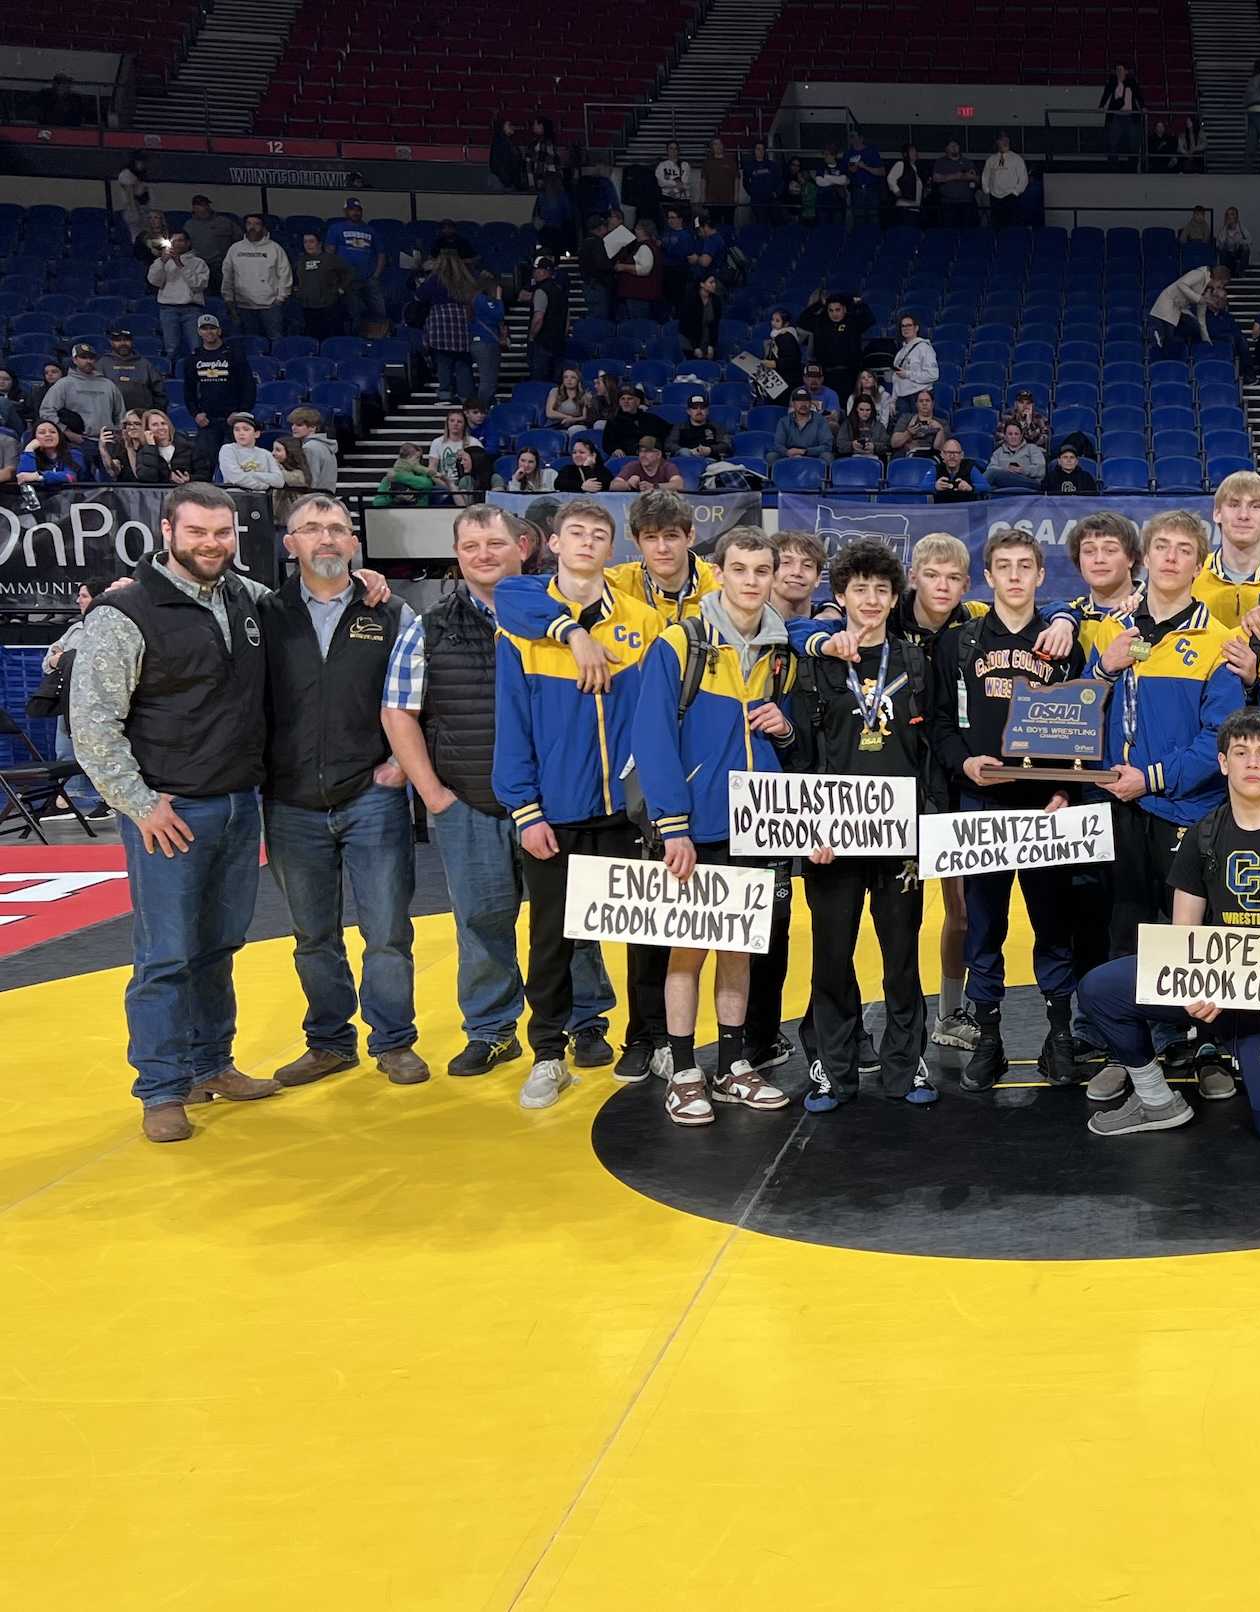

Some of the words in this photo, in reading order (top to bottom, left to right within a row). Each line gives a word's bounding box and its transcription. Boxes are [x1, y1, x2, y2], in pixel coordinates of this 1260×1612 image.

[266, 141, 284, 153] 12
[0, 503, 251, 571] nPot
[614, 625, 641, 648] CC
[1175, 638, 1199, 666] CC
[1012, 649, 1054, 683] COUNTY
[1028, 702, 1081, 722] OSAA
[1051, 727, 1097, 737] WRESTLING
[748, 779, 894, 815] VILLASTRIGO
[734, 805, 753, 836] 10
[755, 818, 824, 848] CROOK
[829, 818, 909, 849] COUNTY
[952, 814, 1066, 847] WENTZEL
[1081, 814, 1105, 838] 12
[935, 846, 1009, 872] CROOK
[1016, 839, 1096, 864] COUNTY
[608, 864, 730, 907] ENGLAND
[744, 883, 768, 911] 12
[584, 901, 658, 937] CROOK
[664, 907, 755, 946] COUNTY
[1156, 965, 1237, 1000] CROOK
